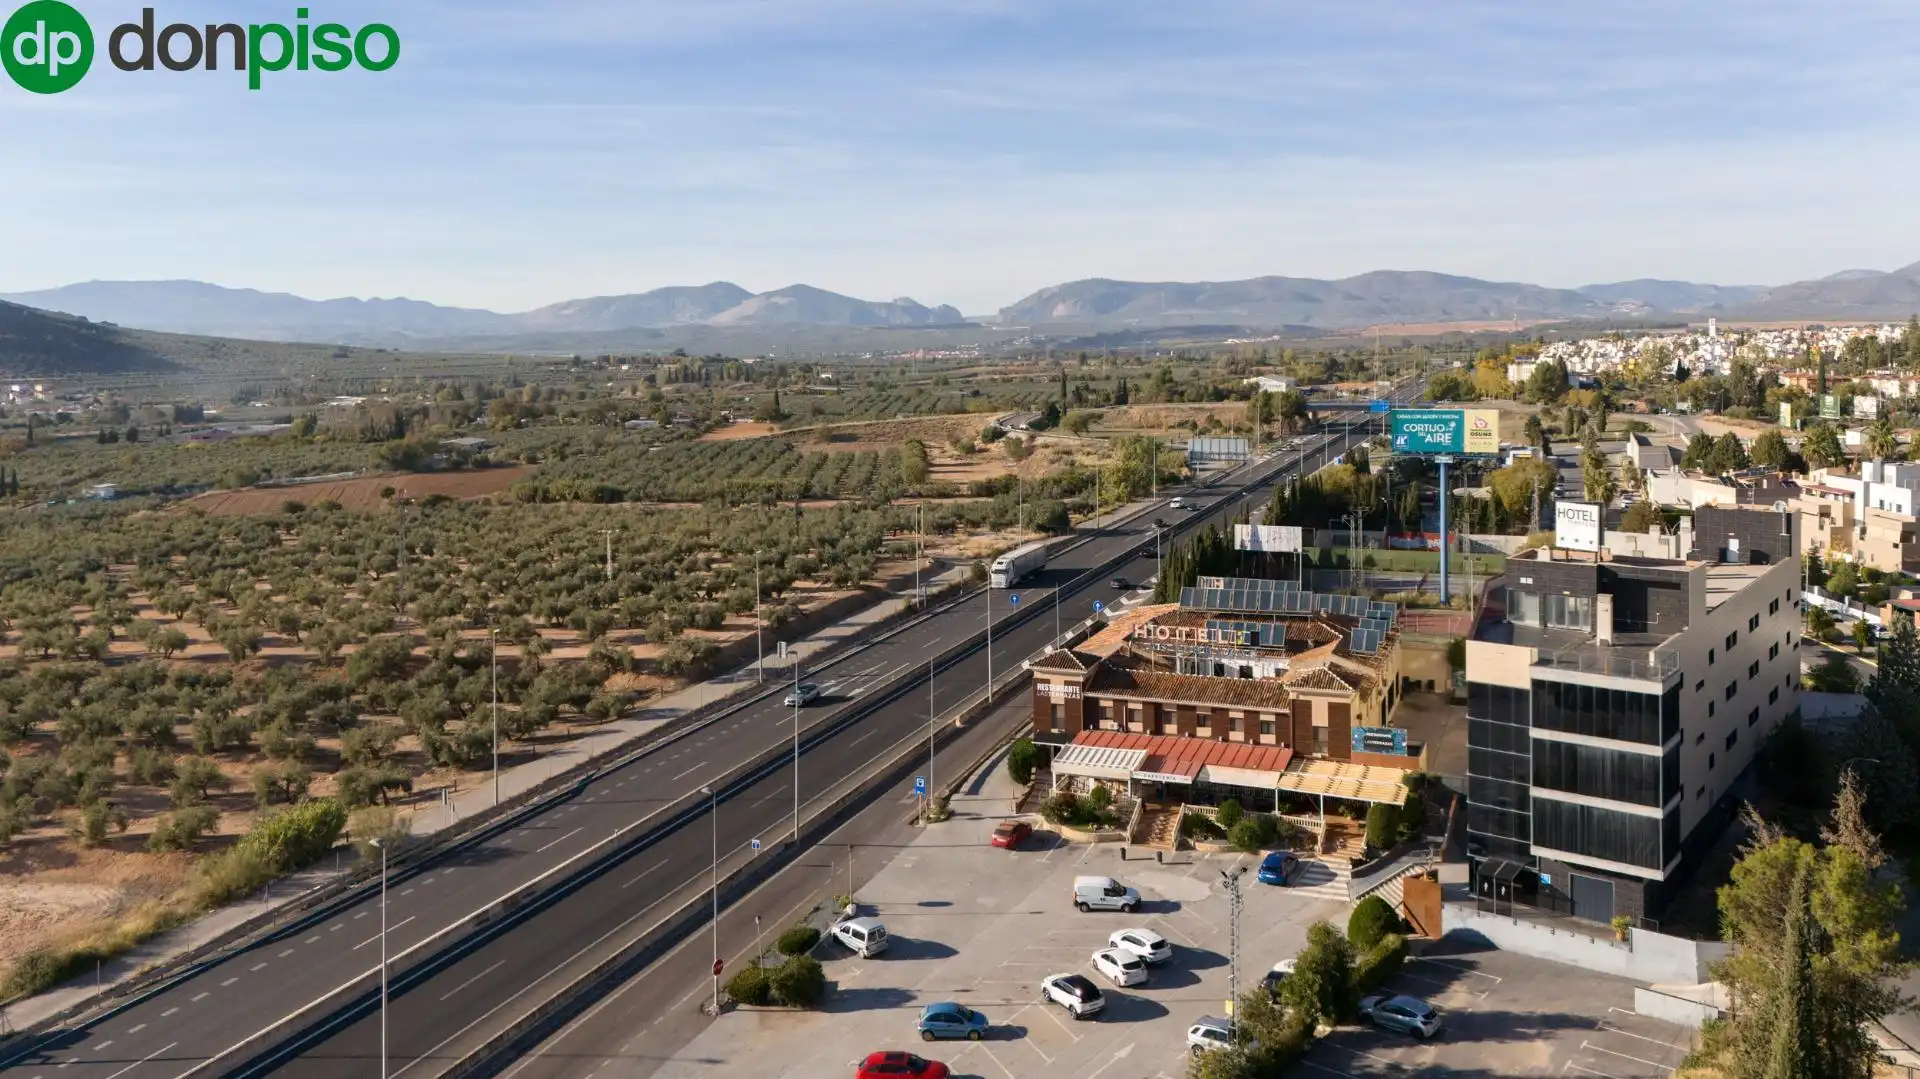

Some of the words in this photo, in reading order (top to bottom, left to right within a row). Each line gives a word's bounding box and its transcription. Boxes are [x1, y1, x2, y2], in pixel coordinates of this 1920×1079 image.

[1403, 423, 1445, 432] CORTIJO
[1424, 433, 1453, 443] AIRE
[1557, 507, 1597, 522] HOTEL
[1133, 623, 1229, 644] HOTEL
[1036, 683, 1081, 694] RESTAURANTE
